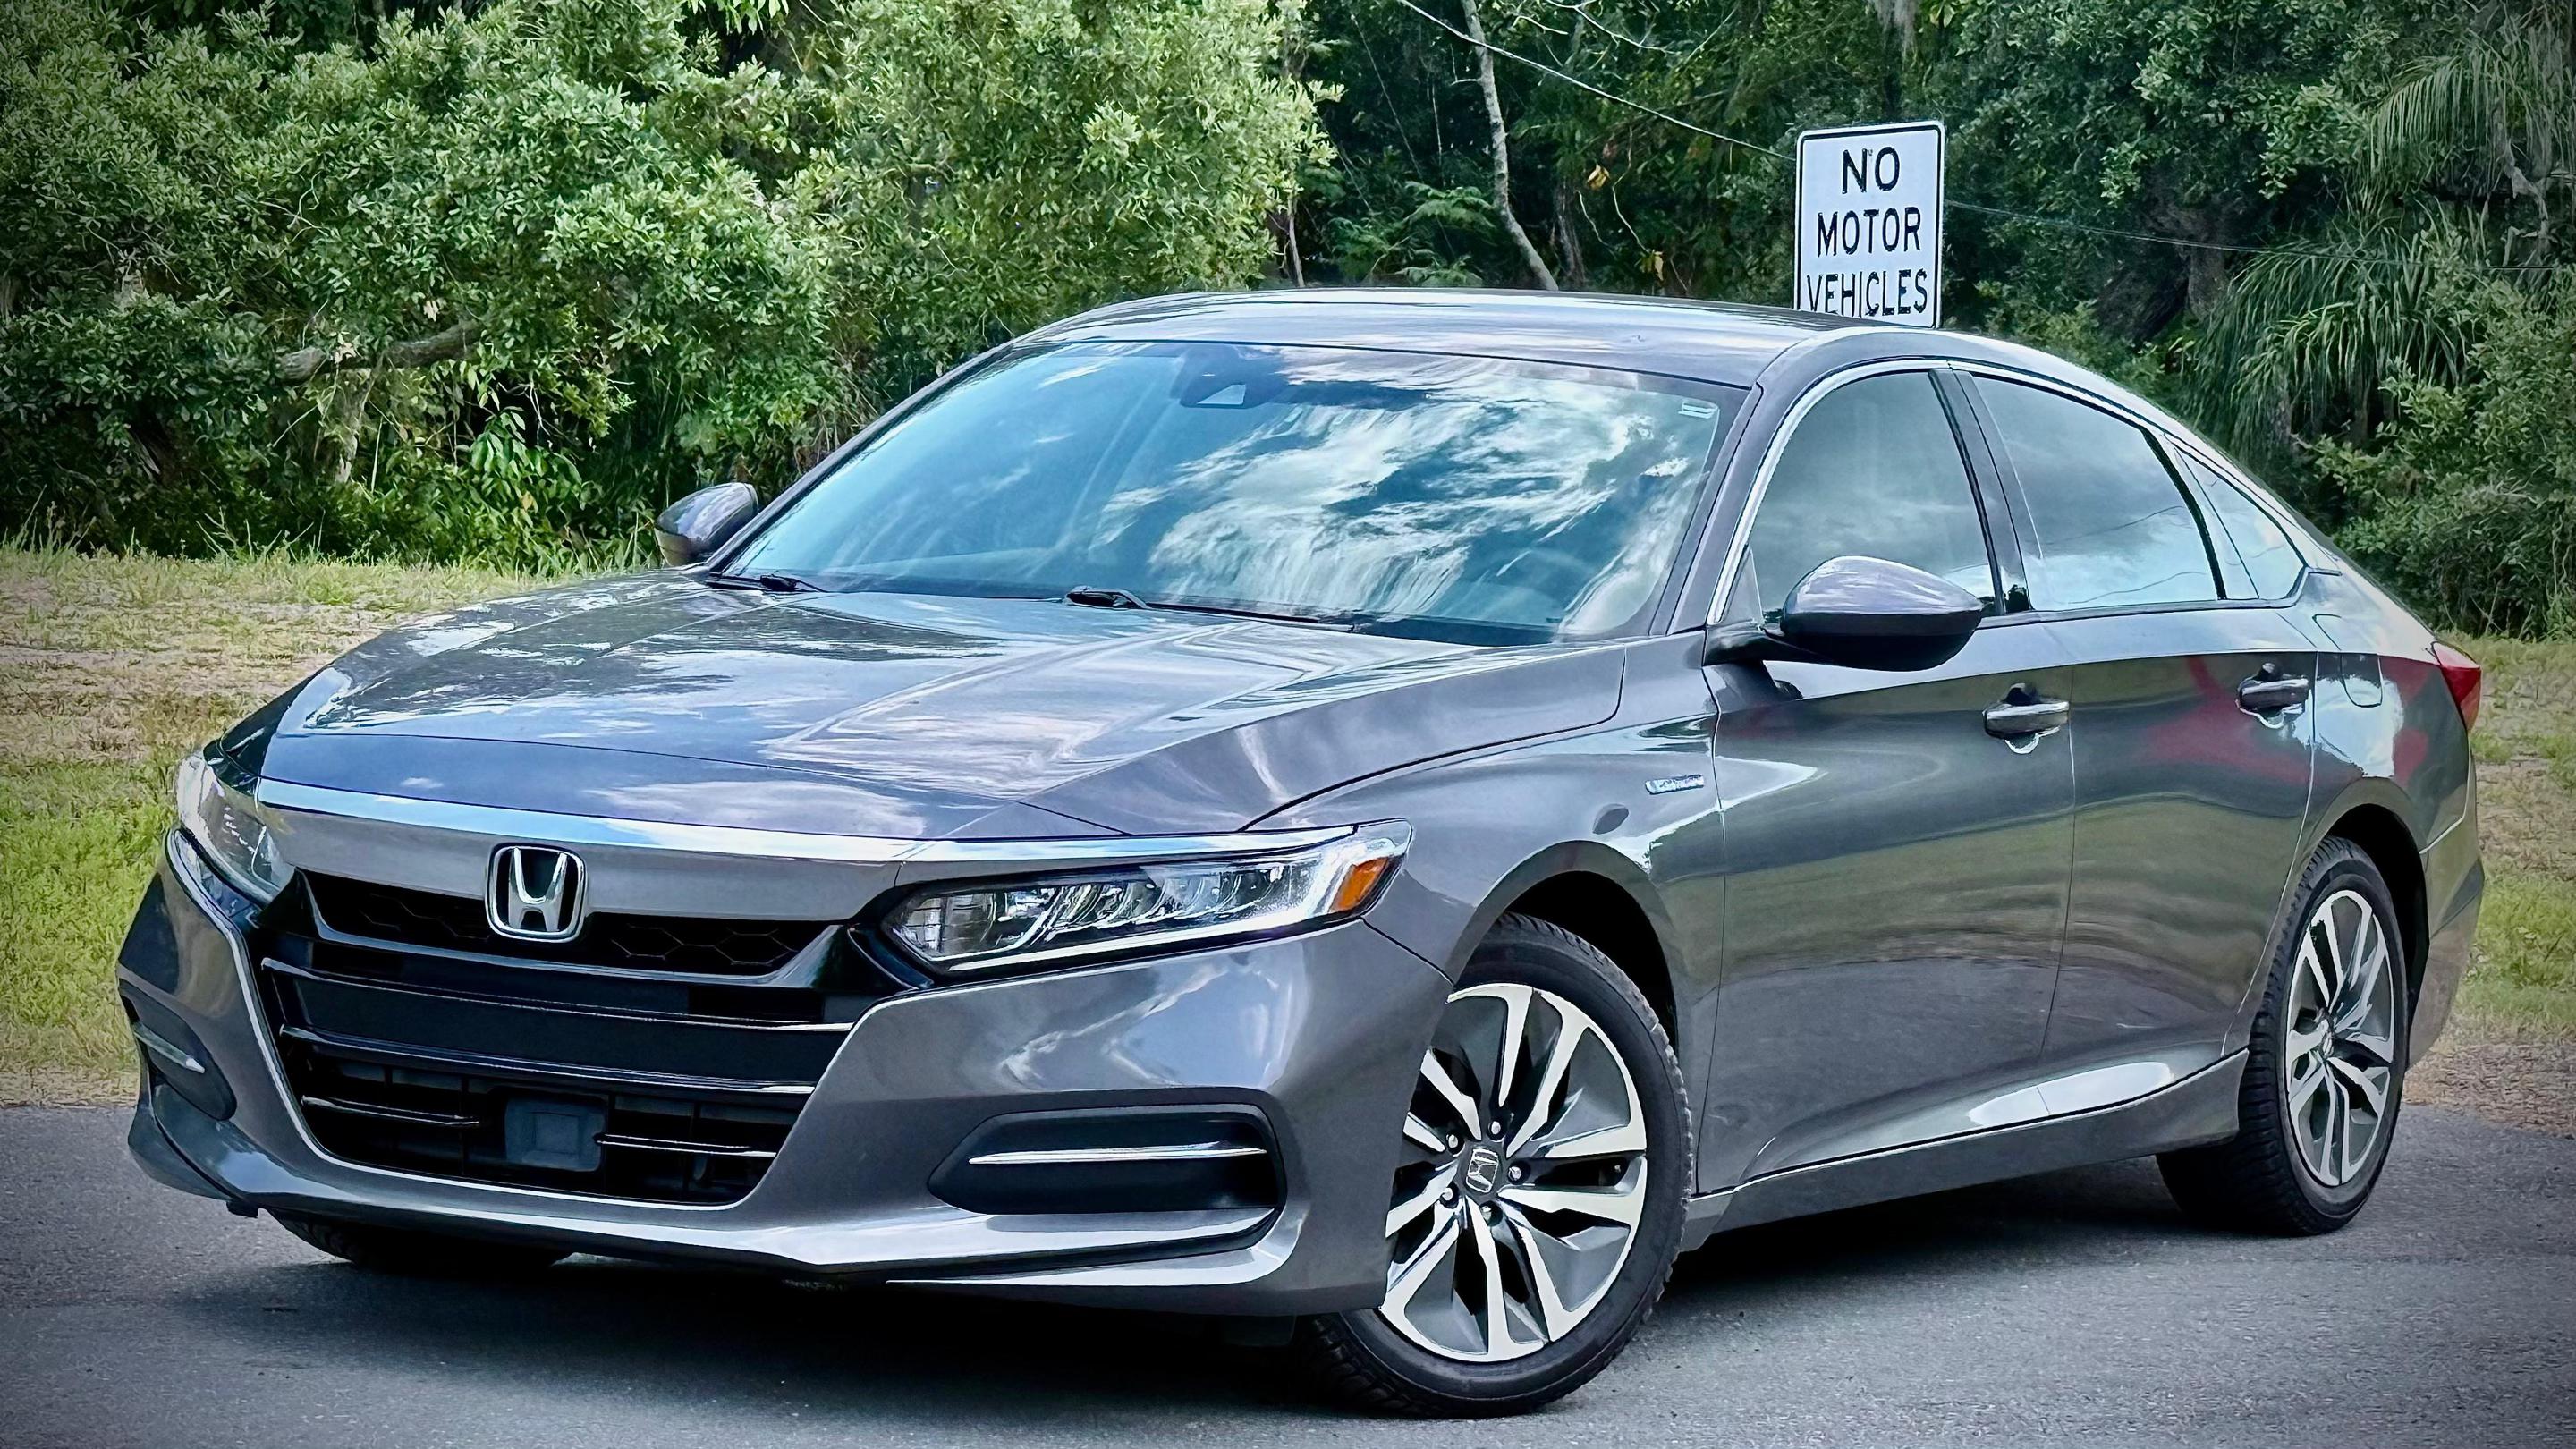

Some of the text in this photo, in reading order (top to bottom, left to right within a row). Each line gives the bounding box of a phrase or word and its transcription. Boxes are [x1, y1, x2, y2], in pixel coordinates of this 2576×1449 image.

[1842, 147, 1900, 194] NO
[1817, 207, 1921, 258] MOTOR
[1806, 268, 1928, 318] VEHICLES
